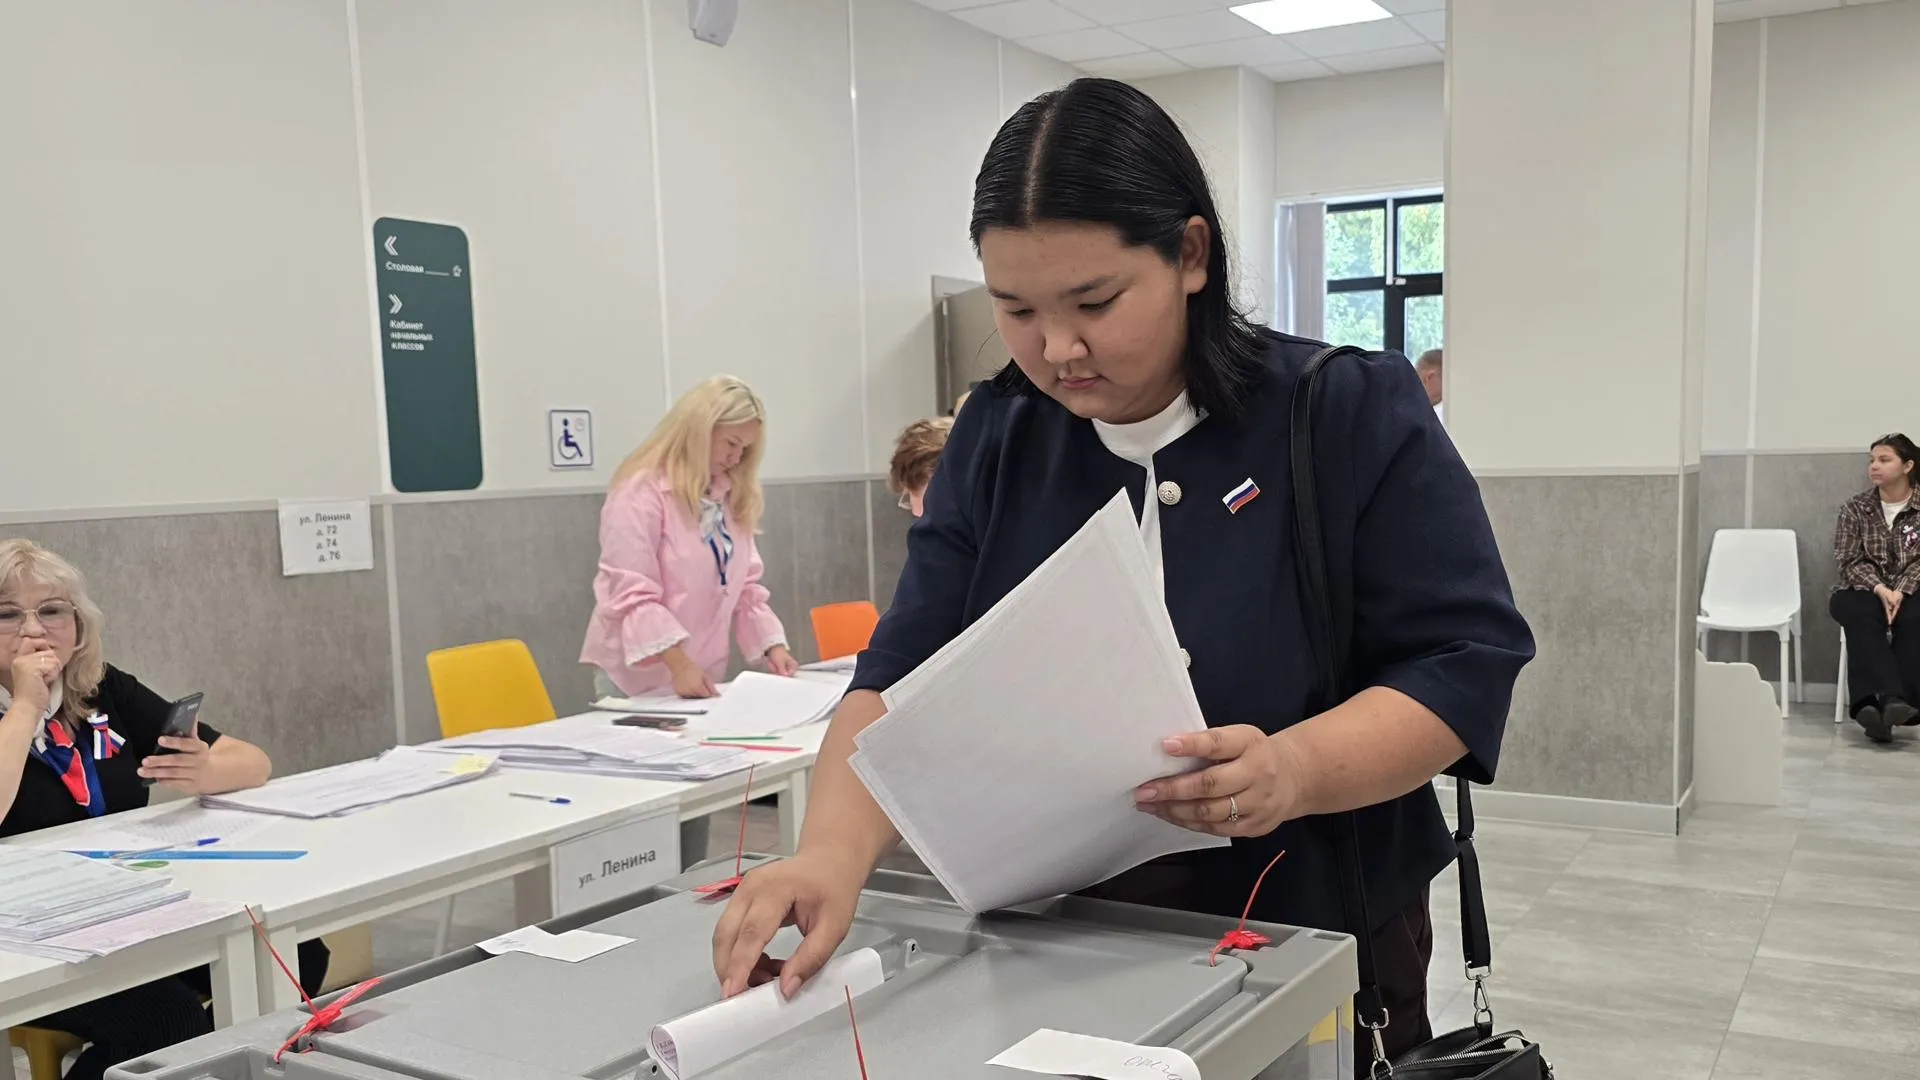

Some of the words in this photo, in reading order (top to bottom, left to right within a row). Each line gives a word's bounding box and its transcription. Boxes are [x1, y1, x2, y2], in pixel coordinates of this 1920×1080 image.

[385, 261, 424, 273] Столовая
[390, 320, 423, 330] Кабинет
[391, 342, 424, 351] классов
[299, 516, 312, 526] ул.
[315, 512, 352, 523] Ленина
[327, 524, 338, 535] 72
[326, 537, 338, 548] 74
[329, 550, 341, 561] 76
[578, 873, 596, 889] ул.
[601, 849, 656, 877] Ленина
